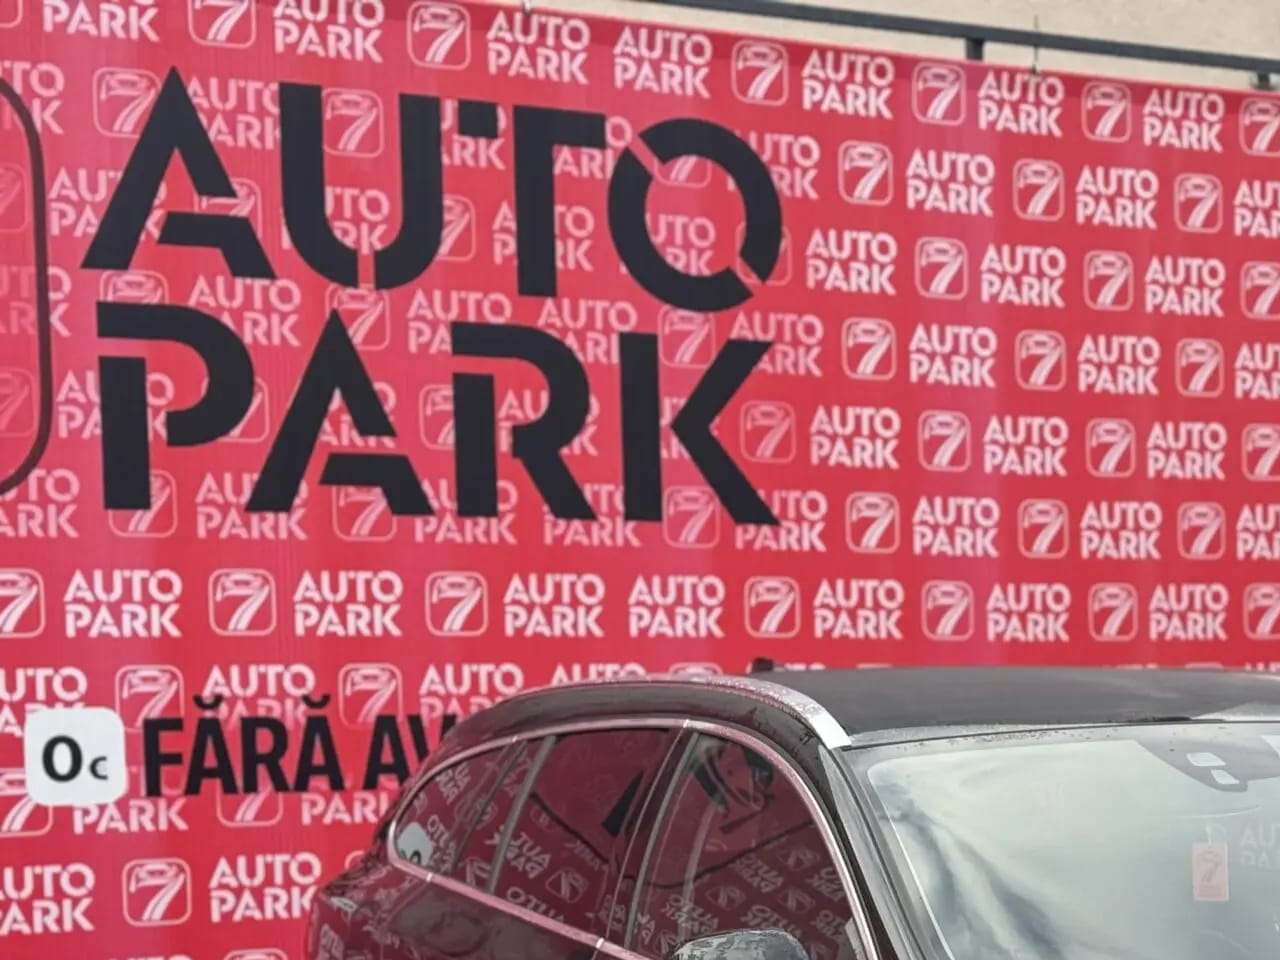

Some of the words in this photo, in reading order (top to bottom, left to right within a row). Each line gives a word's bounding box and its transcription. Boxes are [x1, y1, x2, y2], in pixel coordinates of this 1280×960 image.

[43, 2, 160, 42] PARK
[486, 10, 590, 50] AUTO
[275, 20, 383, 62] PARK
[614, 25, 712, 63] AUTO
[488, 42, 588, 84] PARK
[614, 58, 711, 98] PARK
[802, 49, 895, 87] AUTO
[803, 83, 893, 119] PARK
[978, 71, 1064, 107] AUTO
[979, 101, 1062, 138] PARK
[1144, 90, 1224, 122] AUTO
[1144, 120, 1222, 152] PARK
[906, 149, 994, 184] AUTO
[1077, 166, 1158, 198] AUTO
[81, 66, 783, 313] AUTO
[907, 182, 994, 217] PARK
[1077, 196, 1157, 230] PARK
[806, 230, 896, 263] AUTO
[980, 245, 1066, 275] AUTO
[807, 260, 896, 295] PARK
[1145, 258, 1225, 288] AUTO
[189, 276, 301, 312] AUTO
[407, 287, 512, 324] AUTO
[980, 276, 1066, 308] PARK
[1146, 287, 1224, 317] PARK
[537, 298, 637, 333] AUTO
[729, 312, 824, 345] AUTO
[909, 324, 997, 357] AUTO
[1079, 336, 1160, 366] AUTO
[910, 354, 996, 388] PARK
[1079, 364, 1158, 395] PARK
[96, 301, 780, 525] PARK
[811, 407, 900, 437] AUTO
[984, 416, 1069, 446] AUTO
[1147, 422, 1227, 451] AUTO
[811, 437, 899, 470] PARK
[984, 447, 1067, 476] PARK
[1148, 450, 1225, 480] PARK
[196, 506, 307, 540] PARK
[913, 497, 999, 527] AUTO
[1081, 501, 1162, 531] AUTO
[913, 526, 998, 558] PARK
[1082, 530, 1161, 560] PARK
[65, 570, 182, 603] AUTO
[294, 570, 402, 602] AUTO
[504, 574, 605, 605] AUTO
[629, 576, 724, 606] AUTO
[814, 579, 903, 609] AUTO
[987, 583, 1071, 612] AUTO
[1150, 584, 1228, 612] AUTO
[65, 602, 181, 638] PARK
[294, 601, 402, 637] PARK
[504, 605, 604, 638] PARK
[629, 606, 724, 638] PARK
[814, 609, 902, 640] PARK
[987, 612, 1070, 642] PARK
[1150, 612, 1228, 640] PARK
[202, 664, 315, 697] AUTO
[419, 664, 523, 696] AUTO
[144, 692, 343, 800] FĂRĂ
[209, 853, 321, 890] AUTO
